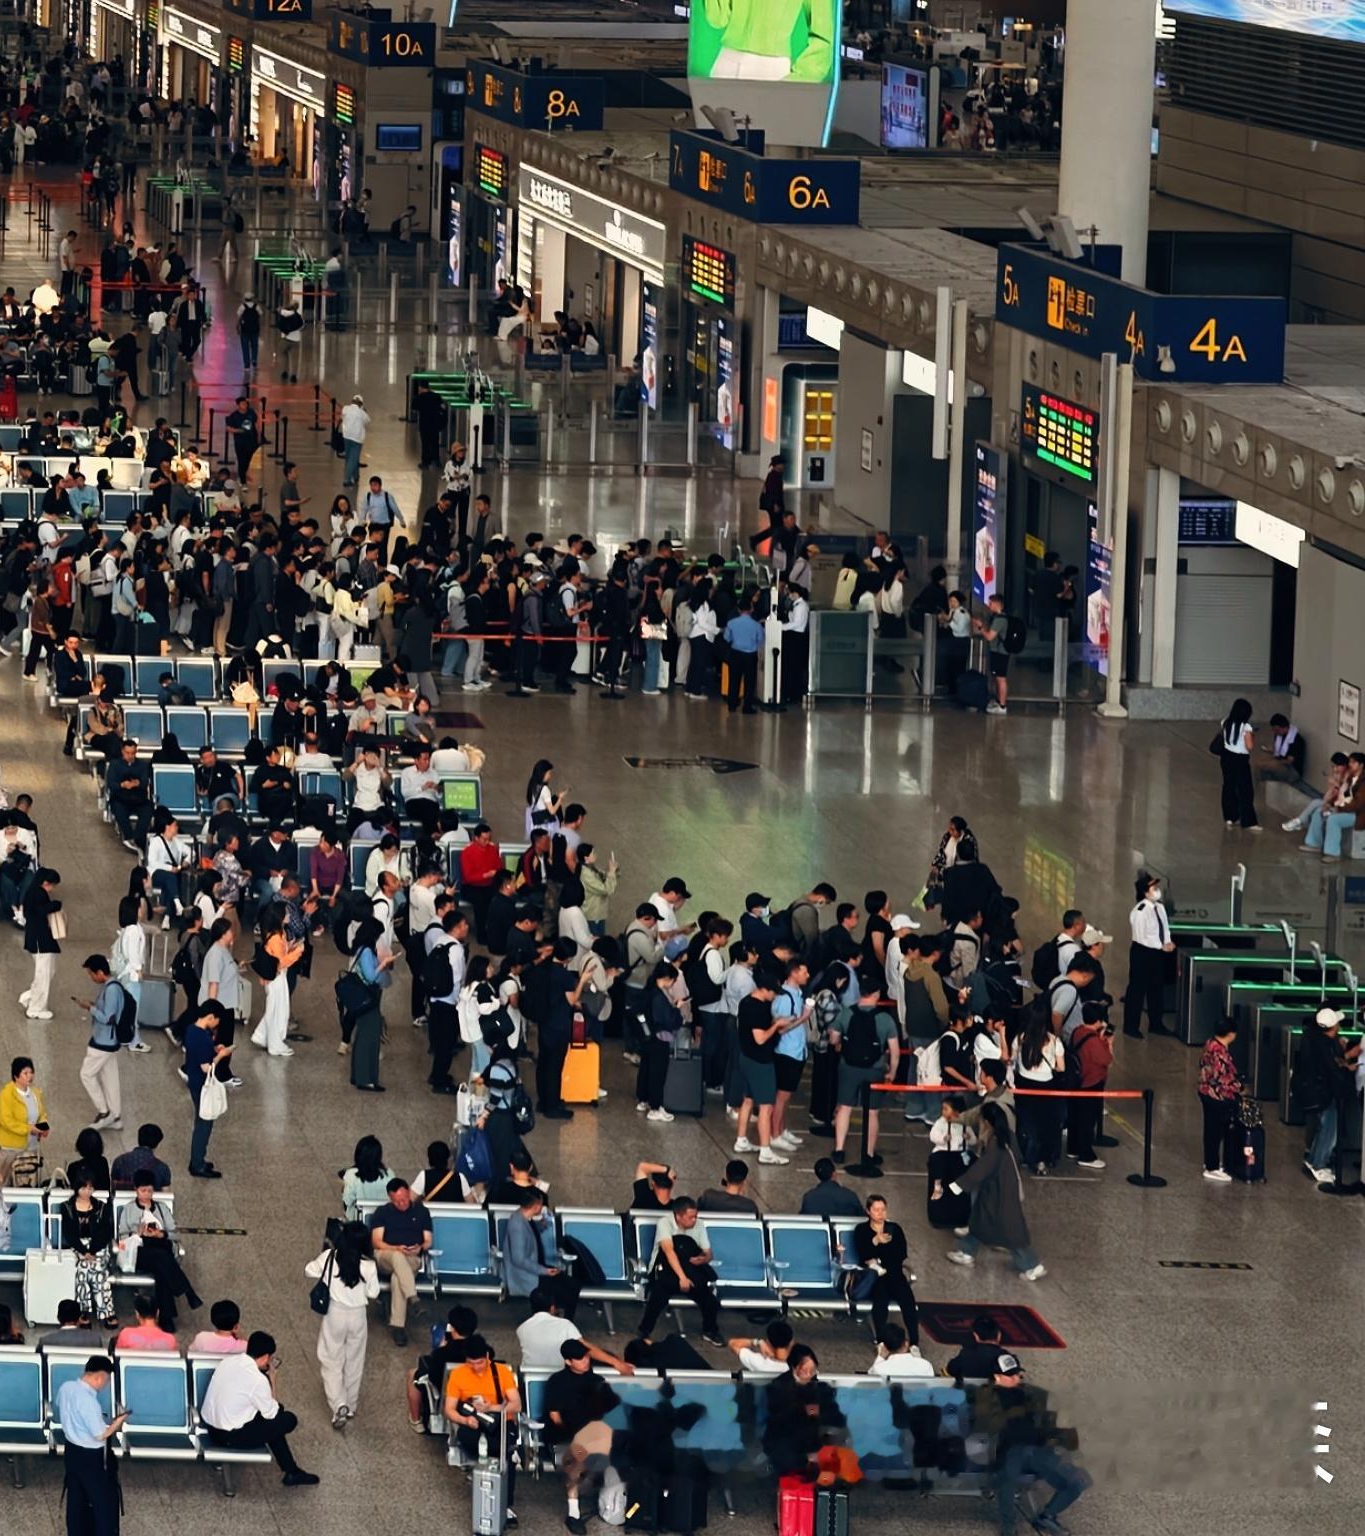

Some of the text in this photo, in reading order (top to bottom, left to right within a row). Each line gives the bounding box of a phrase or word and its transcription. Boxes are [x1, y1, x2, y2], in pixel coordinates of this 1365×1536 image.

[380, 33, 423, 56] 10A
[547, 89, 581, 117] 8A
[743, 170, 756, 205] 6A
[788, 175, 831, 210] 6A
[1002, 264, 1019, 306] 5A
[1066, 286, 1096, 319] 检票口
[1124, 310, 1145, 355] 4A
[1189, 317, 1248, 363] 4A
